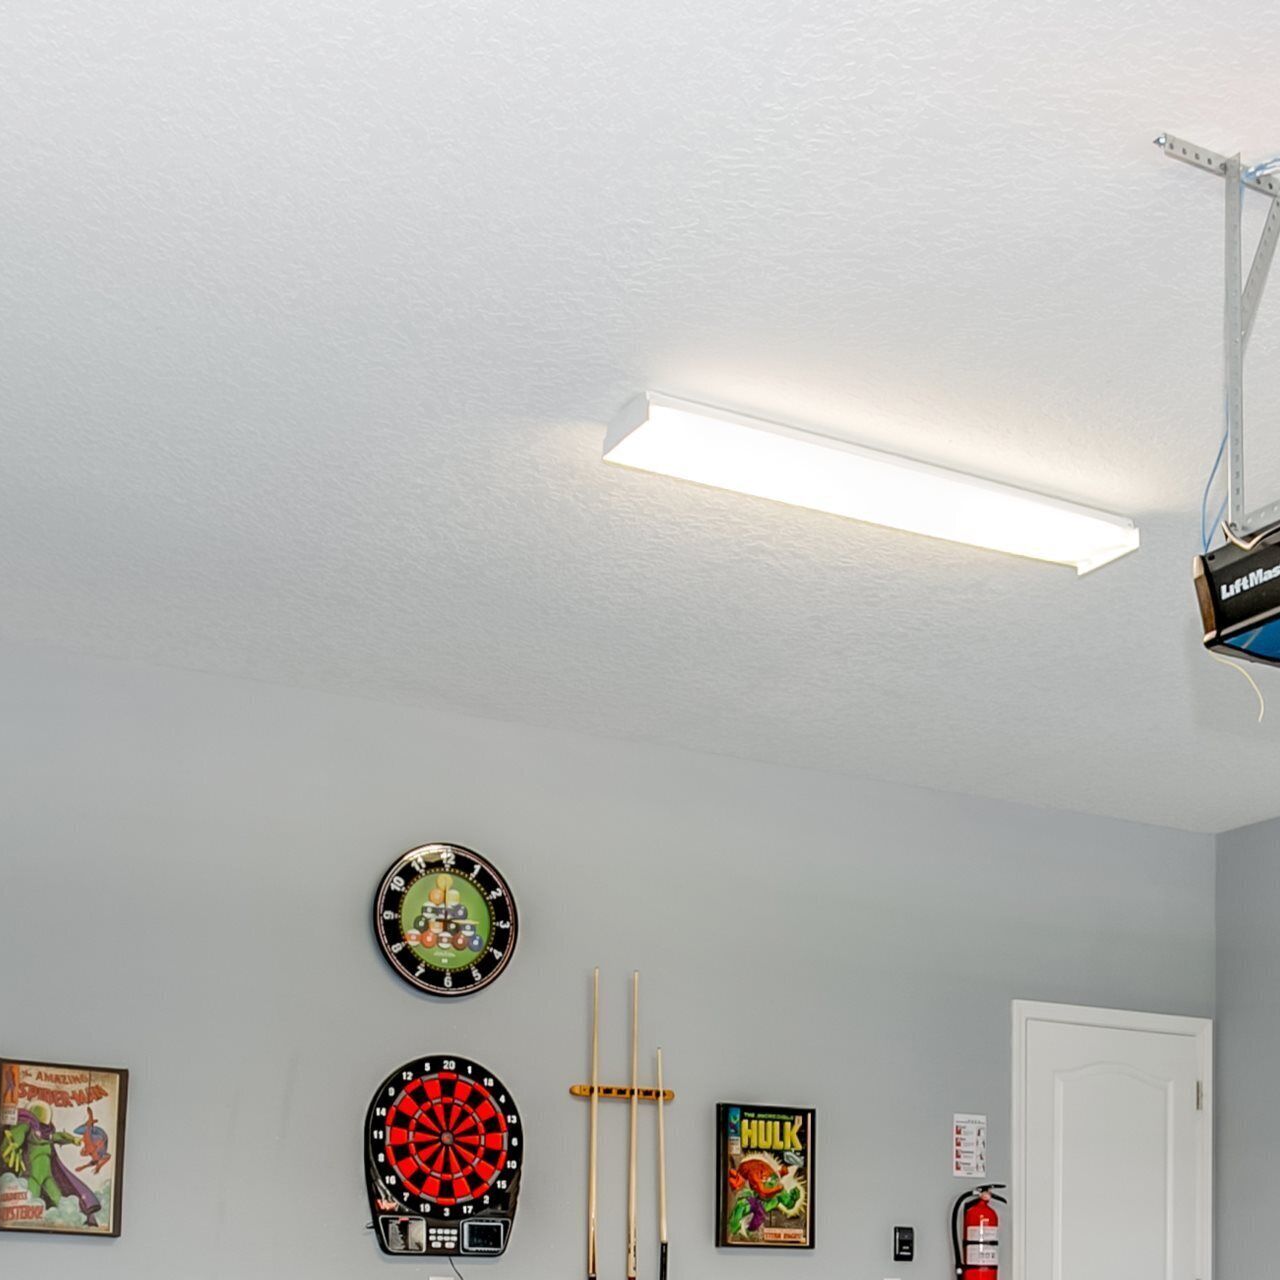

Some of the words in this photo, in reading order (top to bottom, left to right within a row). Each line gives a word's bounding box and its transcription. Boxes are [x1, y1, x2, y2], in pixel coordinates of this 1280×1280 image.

[440, 852, 456, 865] 12
[411, 856, 426, 872] 11
[472, 864, 481, 877] 1
[390, 876, 405, 892] 10
[490, 888, 503, 900] 2
[383, 910, 394, 920] 9
[499, 920, 510, 929] 3
[391, 942, 402, 953] 8
[493, 948, 503, 960] 4
[415, 966, 426, 977] 7
[471, 969, 482, 981] 5
[443, 976, 453, 988] 6
[424, 1062, 431, 1072] 5
[443, 1060, 456, 1070] 20
[467, 1066, 472, 1074] 1
[35, 1071, 90, 1085] AMAZING
[402, 1071, 413, 1080] 12
[483, 1078, 494, 1087] 18
[19, 1082, 109, 1108] SPIDER-MAN
[388, 1087, 395, 1097] 9
[499, 1095, 506, 1103] 4
[376, 1107, 387, 1117] 14
[507, 1115, 518, 1124] 13
[373, 1130, 384, 1140] 11
[741, 1117, 803, 1151] HULK
[511, 1138, 518, 1147] 6
[378, 1152, 385, 1162] 8
[507, 1160, 517, 1169] 10
[385, 1175, 396, 1185] 16
[496, 1180, 507, 1189] 15
[403, 1192, 410, 1201] 7
[483, 1195, 490, 1205] 2
[420, 1203, 431, 1213] 19
[443, 1207, 451, 1217] 3
[462, 1205, 473, 1214] 17
